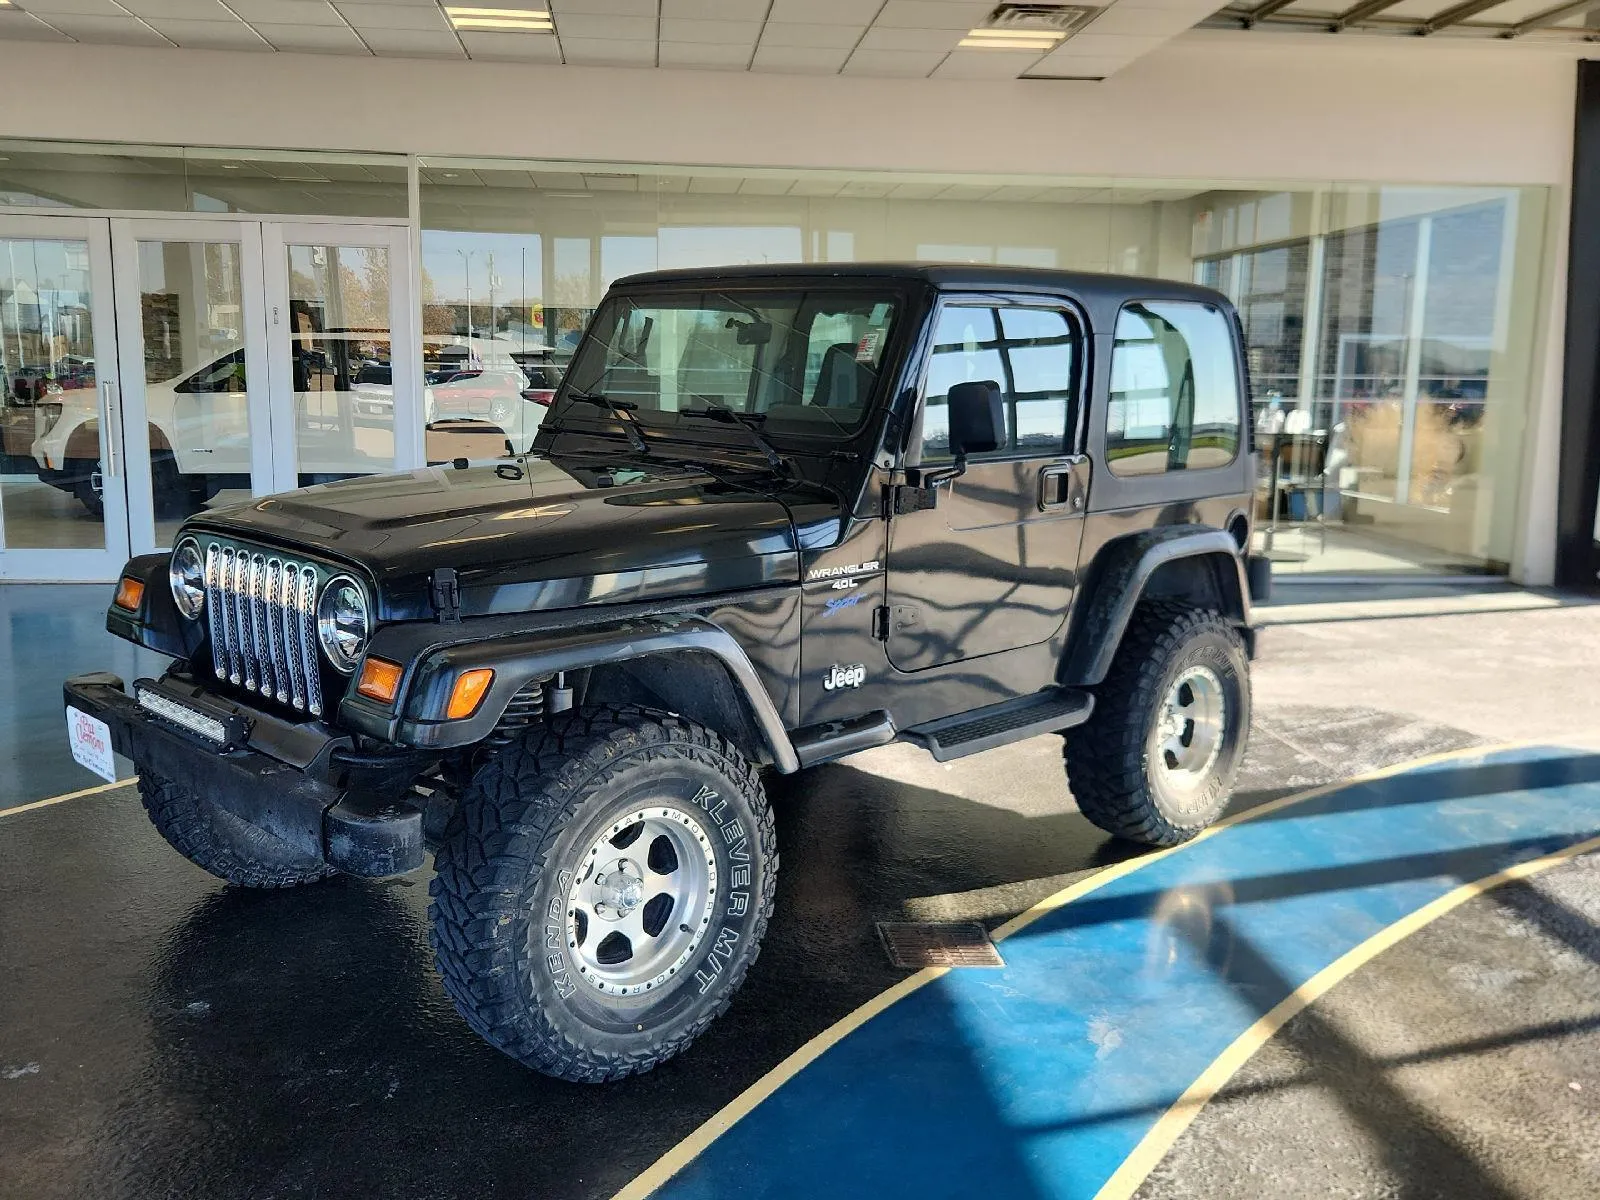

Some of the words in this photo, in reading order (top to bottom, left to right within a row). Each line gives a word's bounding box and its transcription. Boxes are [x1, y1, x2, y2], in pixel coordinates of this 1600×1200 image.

[809, 561, 879, 579] WRANGLER
[824, 664, 866, 690] Jeep
[691, 785, 750, 917] KLEVER
[546, 869, 576, 999] KENDA
[695, 926, 739, 995] M/T
